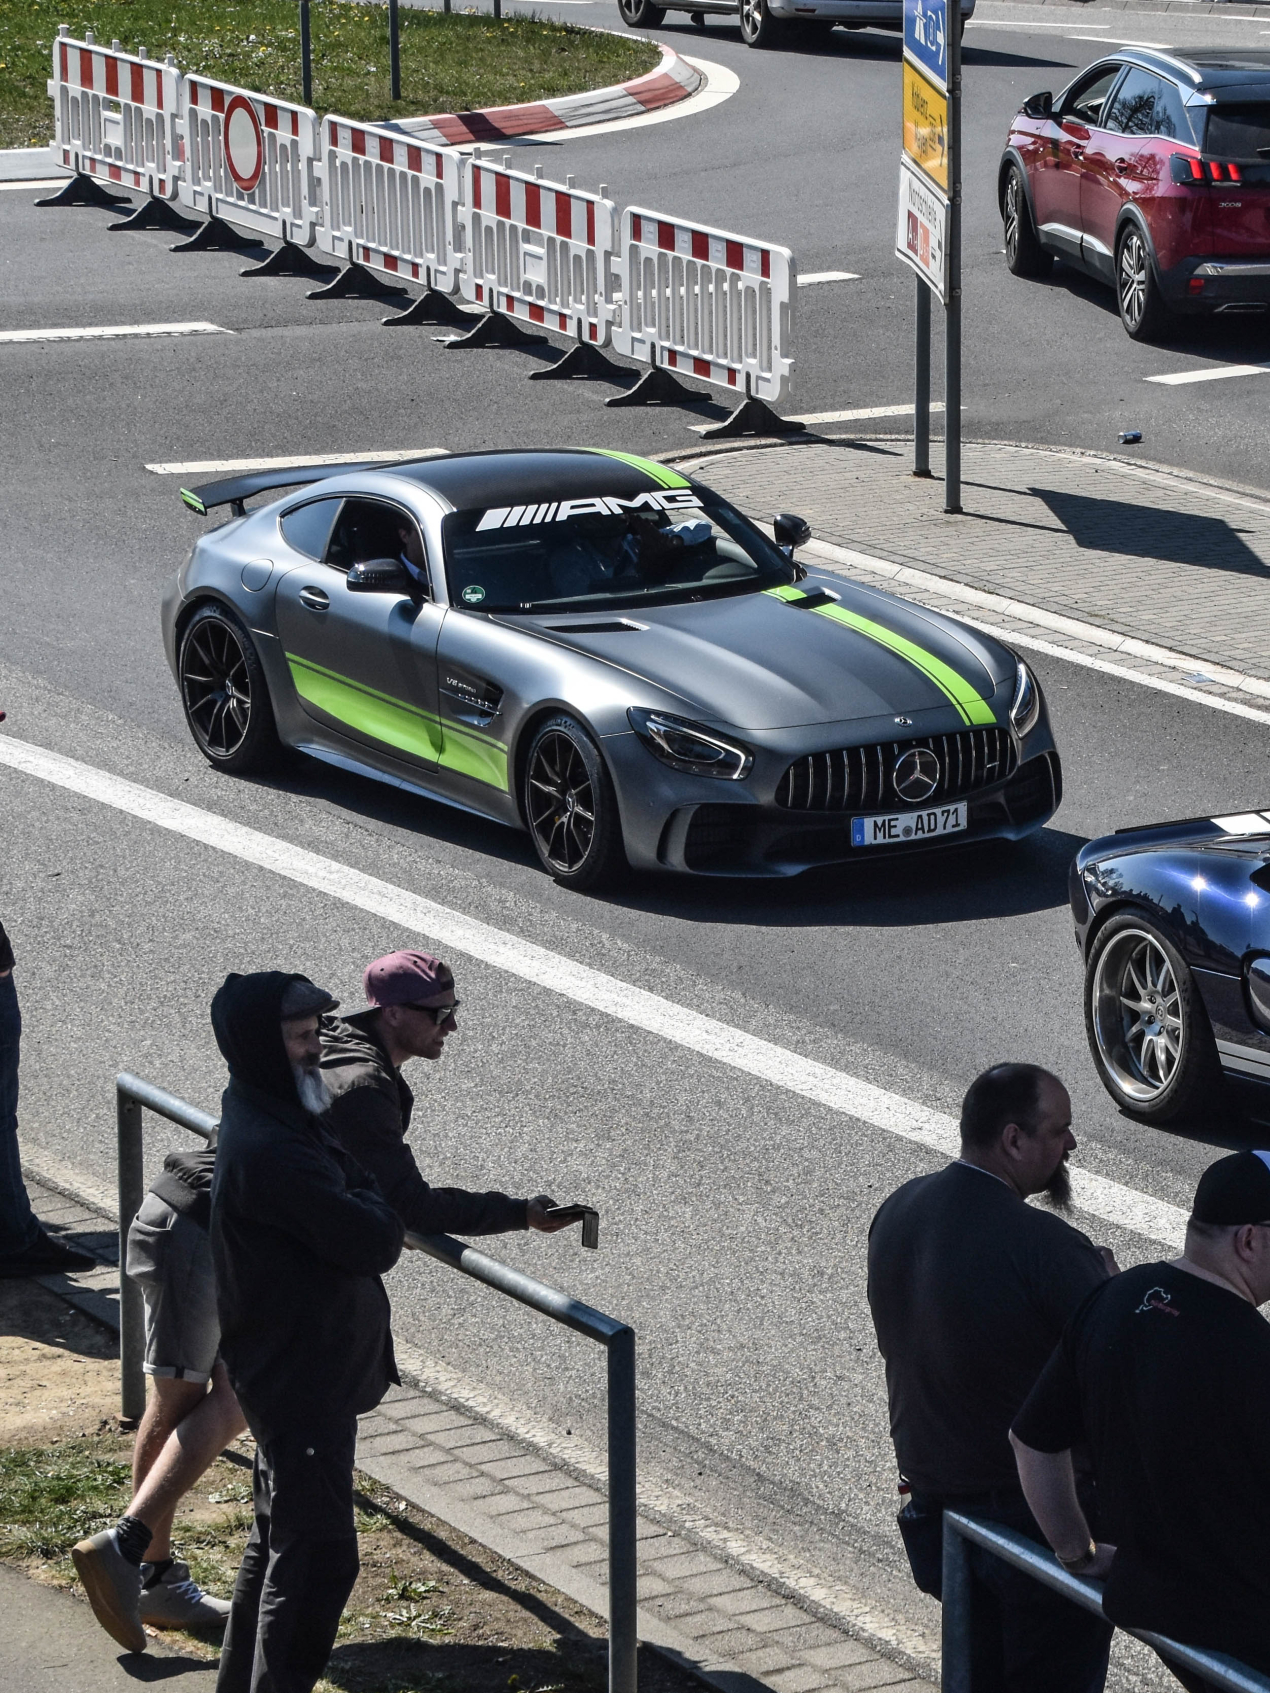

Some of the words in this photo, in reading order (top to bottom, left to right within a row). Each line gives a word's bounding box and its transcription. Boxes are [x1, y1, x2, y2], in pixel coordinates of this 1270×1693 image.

[912, 81, 928, 120] Koblenz
[914, 119, 928, 159] Mayen
[908, 177, 937, 230] Nordschleife
[556, 489, 704, 522] AMG
[446, 677, 458, 686] V8
[873, 817, 900, 841] ME
